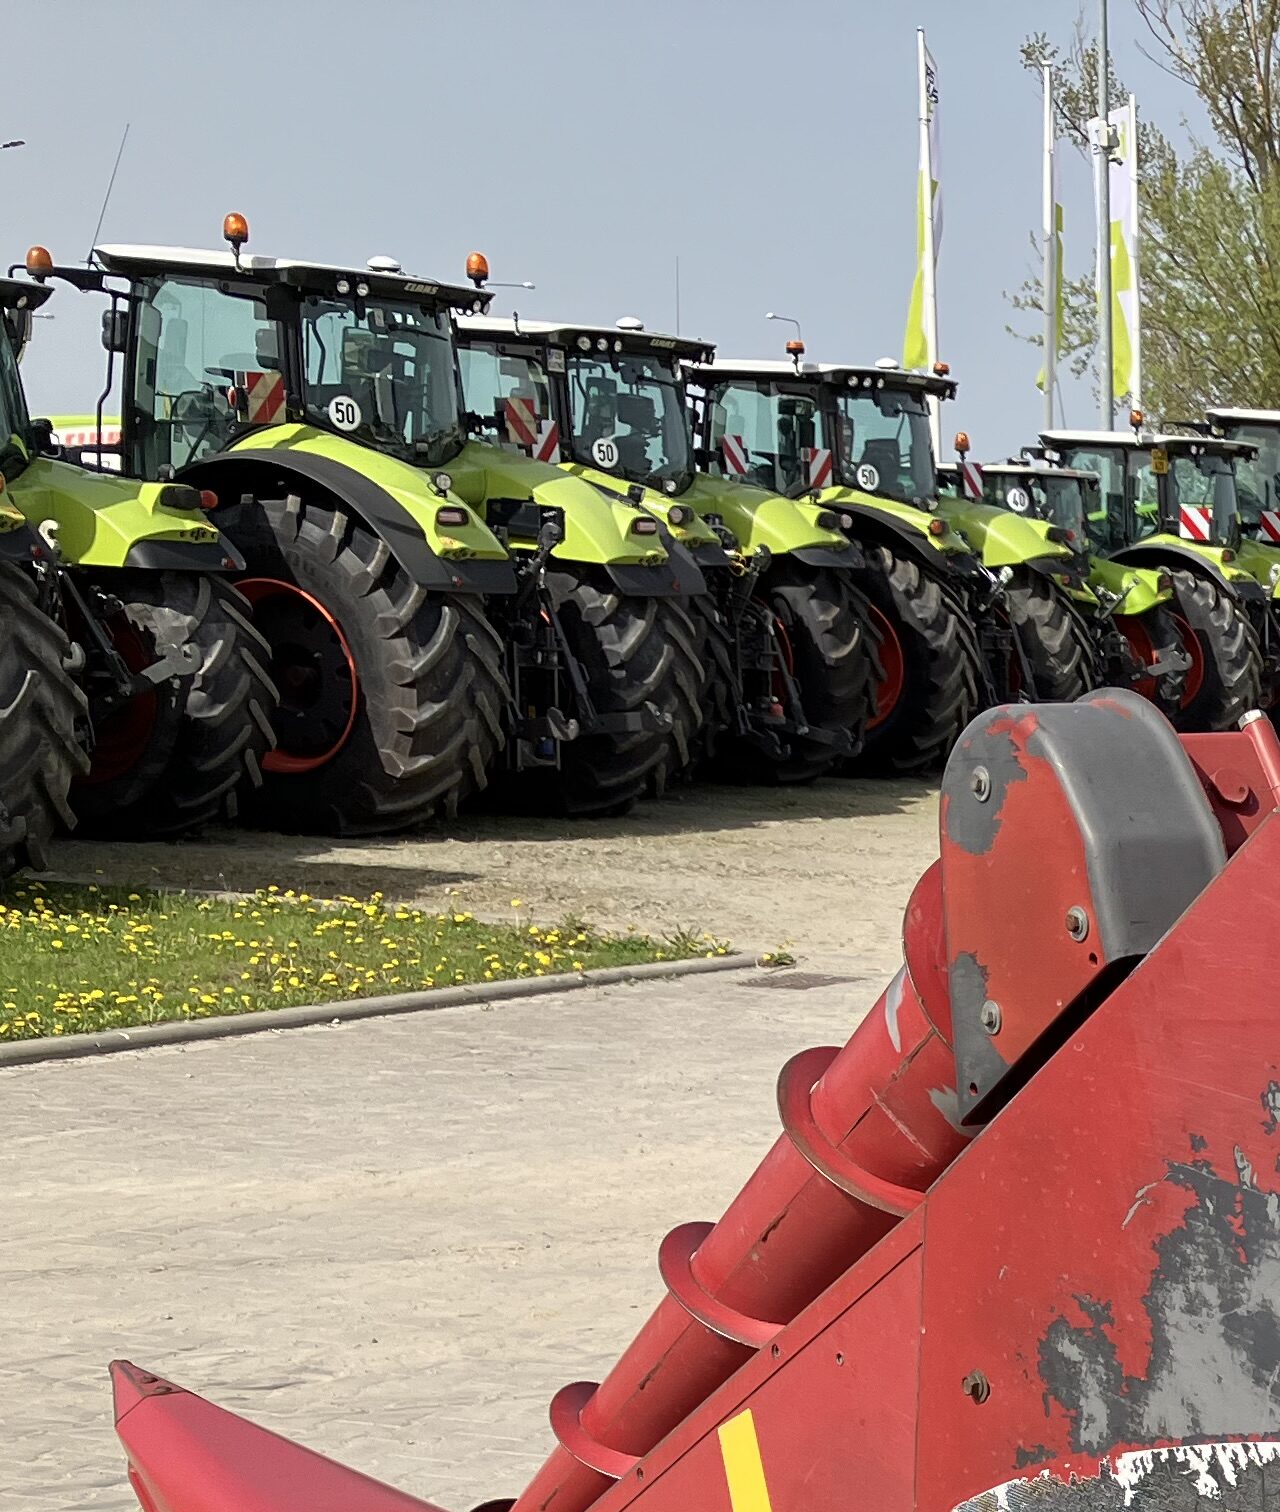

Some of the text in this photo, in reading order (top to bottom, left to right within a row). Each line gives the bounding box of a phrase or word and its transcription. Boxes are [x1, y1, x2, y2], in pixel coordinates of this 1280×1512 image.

[335, 401, 356, 425] 50
[597, 443, 614, 463] 50
[861, 468, 875, 486] 50
